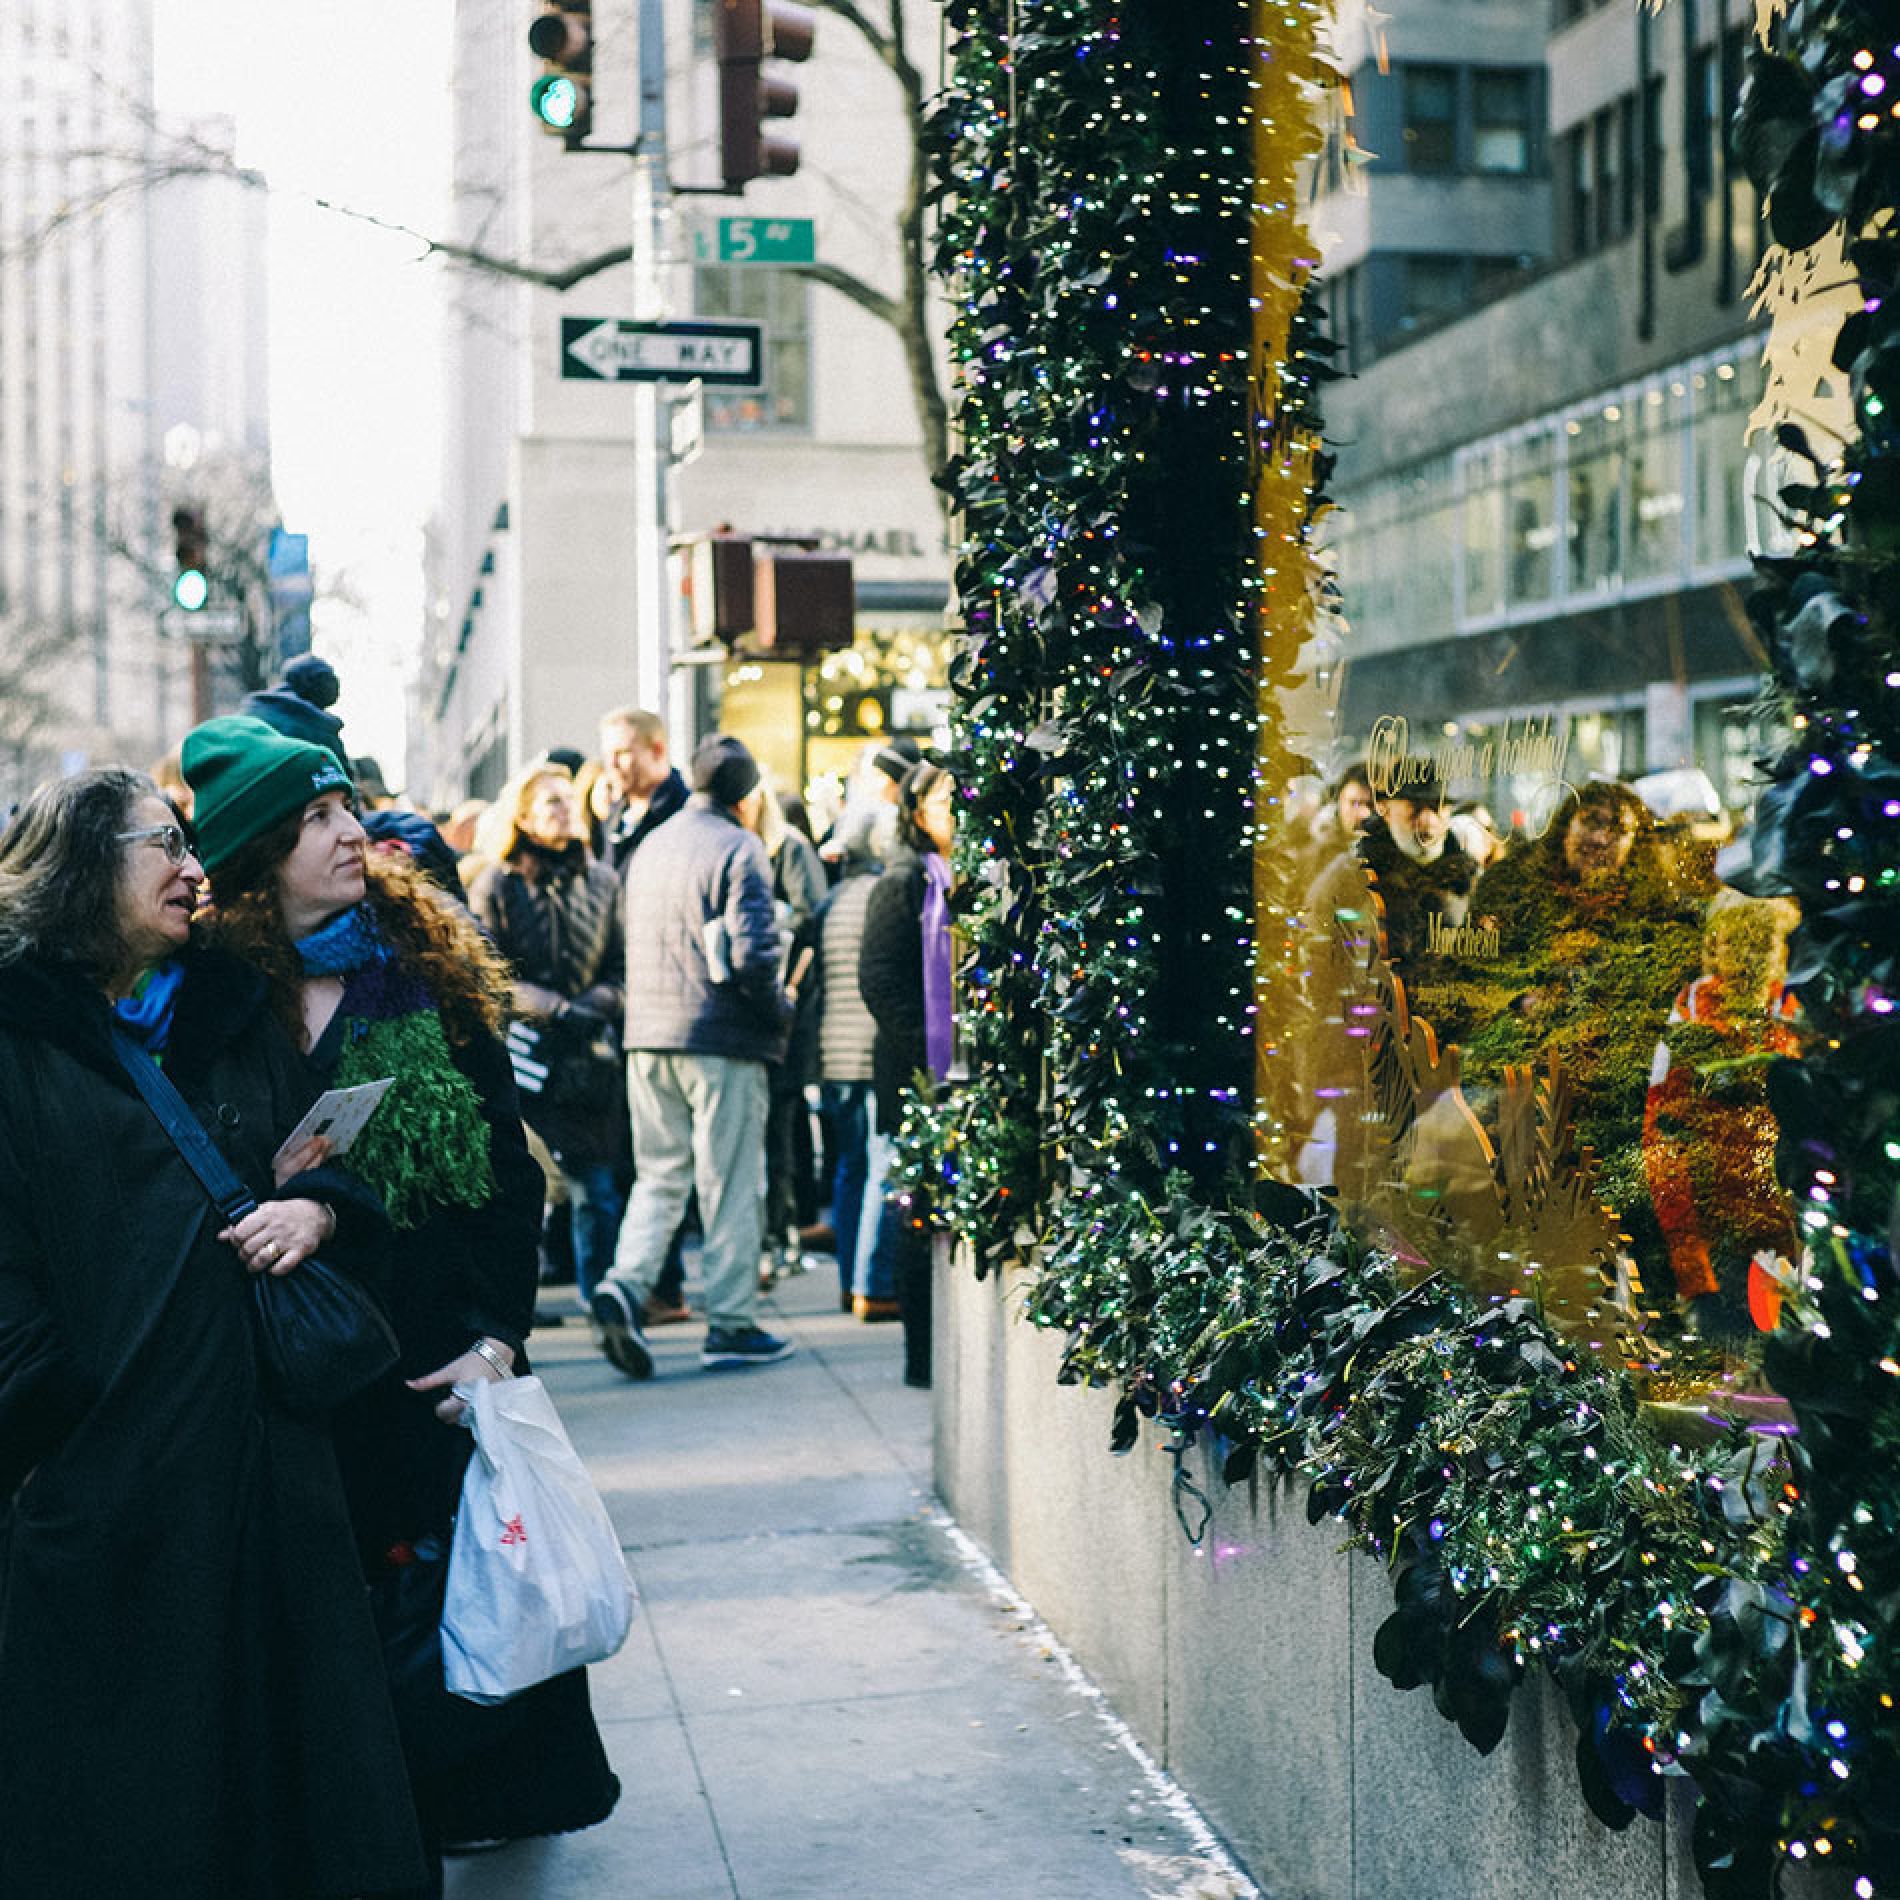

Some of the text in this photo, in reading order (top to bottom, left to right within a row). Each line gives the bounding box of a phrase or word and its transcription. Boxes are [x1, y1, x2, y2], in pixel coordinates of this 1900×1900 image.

[729, 221, 756, 260] 5
[590, 334, 737, 365] ONE WAY
[763, 526, 924, 557] CHAEL
[1368, 715, 1433, 802] Once
[1435, 746, 1475, 814] upon
[1480, 742, 1493, 779] a
